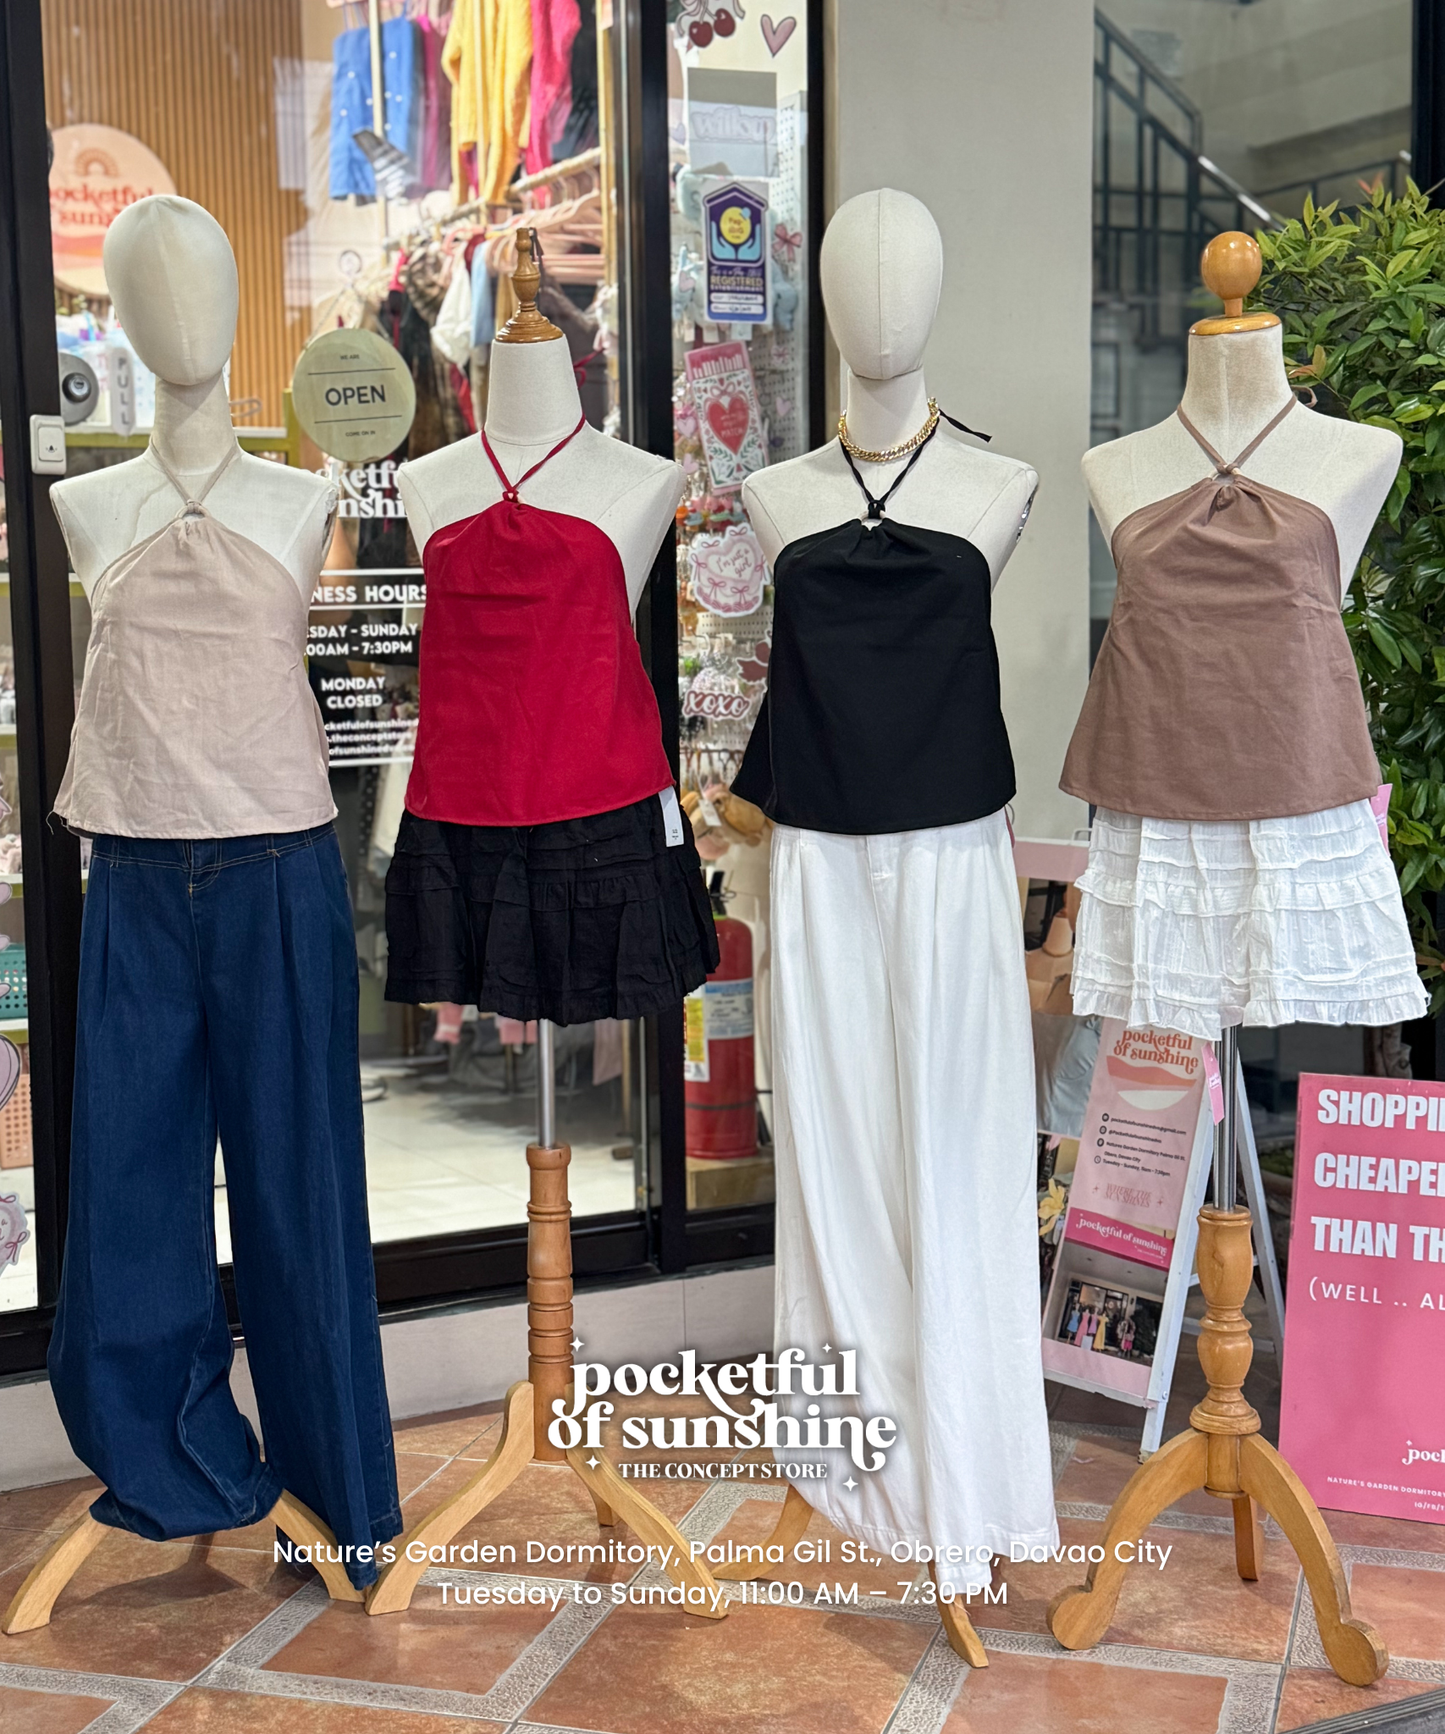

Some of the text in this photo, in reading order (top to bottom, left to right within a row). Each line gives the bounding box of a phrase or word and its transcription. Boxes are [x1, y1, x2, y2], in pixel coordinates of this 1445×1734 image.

[710, 275, 764, 287] REGISTERED
[117, 357, 130, 425] PULL
[325, 384, 386, 407] OPEN
[364, 584, 427, 602] HOURS
[361, 623, 418, 637] SUNDAY
[361, 641, 413, 655] 7:30PM
[321, 676, 386, 692] MONDAY
[326, 694, 383, 709] CLOSED
[1115, 1030, 1193, 1055] pocketful
[1113, 1041, 1198, 1075] of sunshine
[1076, 1218, 1122, 1237] pocketful
[1122, 1232, 1133, 1241] of
[1132, 1238, 1167, 1257] sunshine
[1311, 1216, 1398, 1259] THAN
[1309, 1276, 1382, 1305] (WELL
[1326, 1475, 1365, 1488] NATURE'S
[1366, 1482, 1399, 1492] GARDEN
